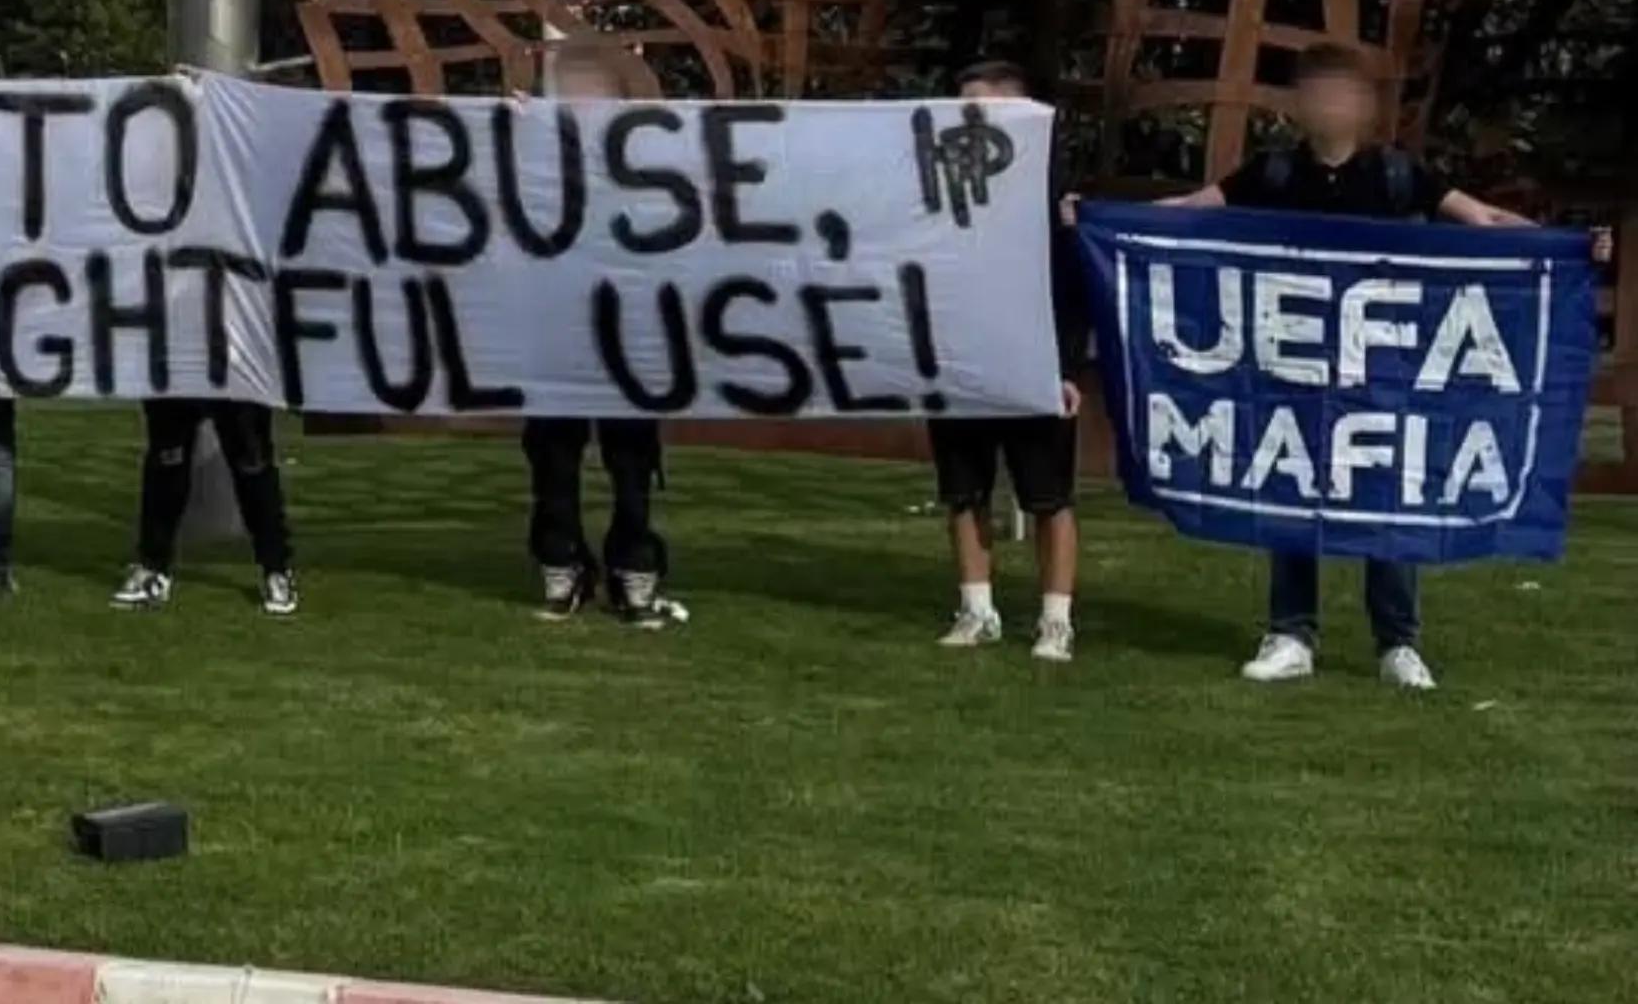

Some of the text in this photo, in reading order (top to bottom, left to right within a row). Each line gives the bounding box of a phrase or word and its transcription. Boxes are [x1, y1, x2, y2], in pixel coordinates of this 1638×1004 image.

[280, 96, 852, 266] ABUSE,
[592, 262, 946, 416] USE!
[1148, 262, 1522, 394] UEFA
[1148, 392, 1510, 505] MAFIA
